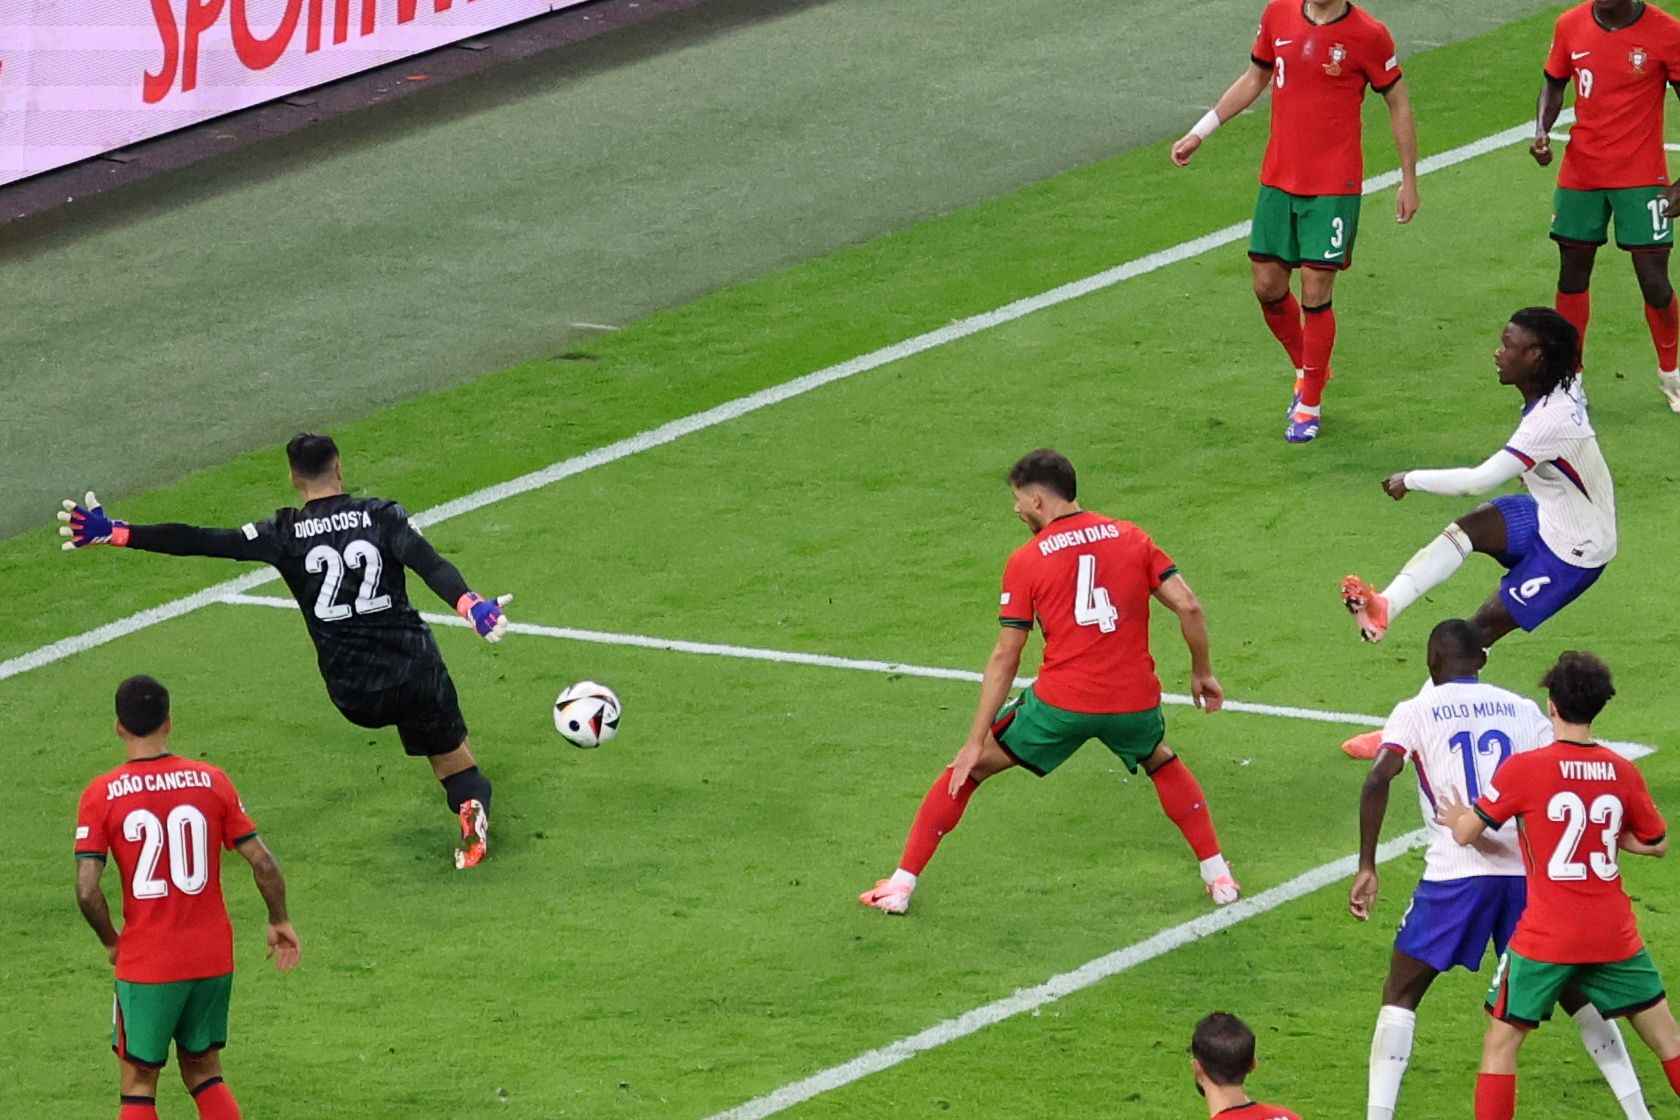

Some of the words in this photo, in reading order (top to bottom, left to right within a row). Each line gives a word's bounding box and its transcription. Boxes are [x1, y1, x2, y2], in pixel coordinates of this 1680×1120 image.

[1275, 56, 1285, 89] 3
[1575, 67, 1594, 99] 19
[1331, 217, 1343, 248] 3
[294, 517, 332, 538] DIOGO
[331, 511, 372, 531] COSTA
[1038, 530, 1087, 556] RÚBEN
[1084, 524, 1119, 543] DIAS
[305, 540, 392, 622] 22
[1074, 554, 1118, 633] 4
[1520, 576, 1551, 598] 6
[1431, 704, 1469, 721] KOLO
[1473, 702, 1515, 718] MUANI
[106, 773, 142, 800] JOÃO
[144, 771, 211, 792] CANCELO
[1559, 760, 1617, 781] VITINHA
[123, 804, 208, 900] 20
[1547, 791, 1624, 881] 23
